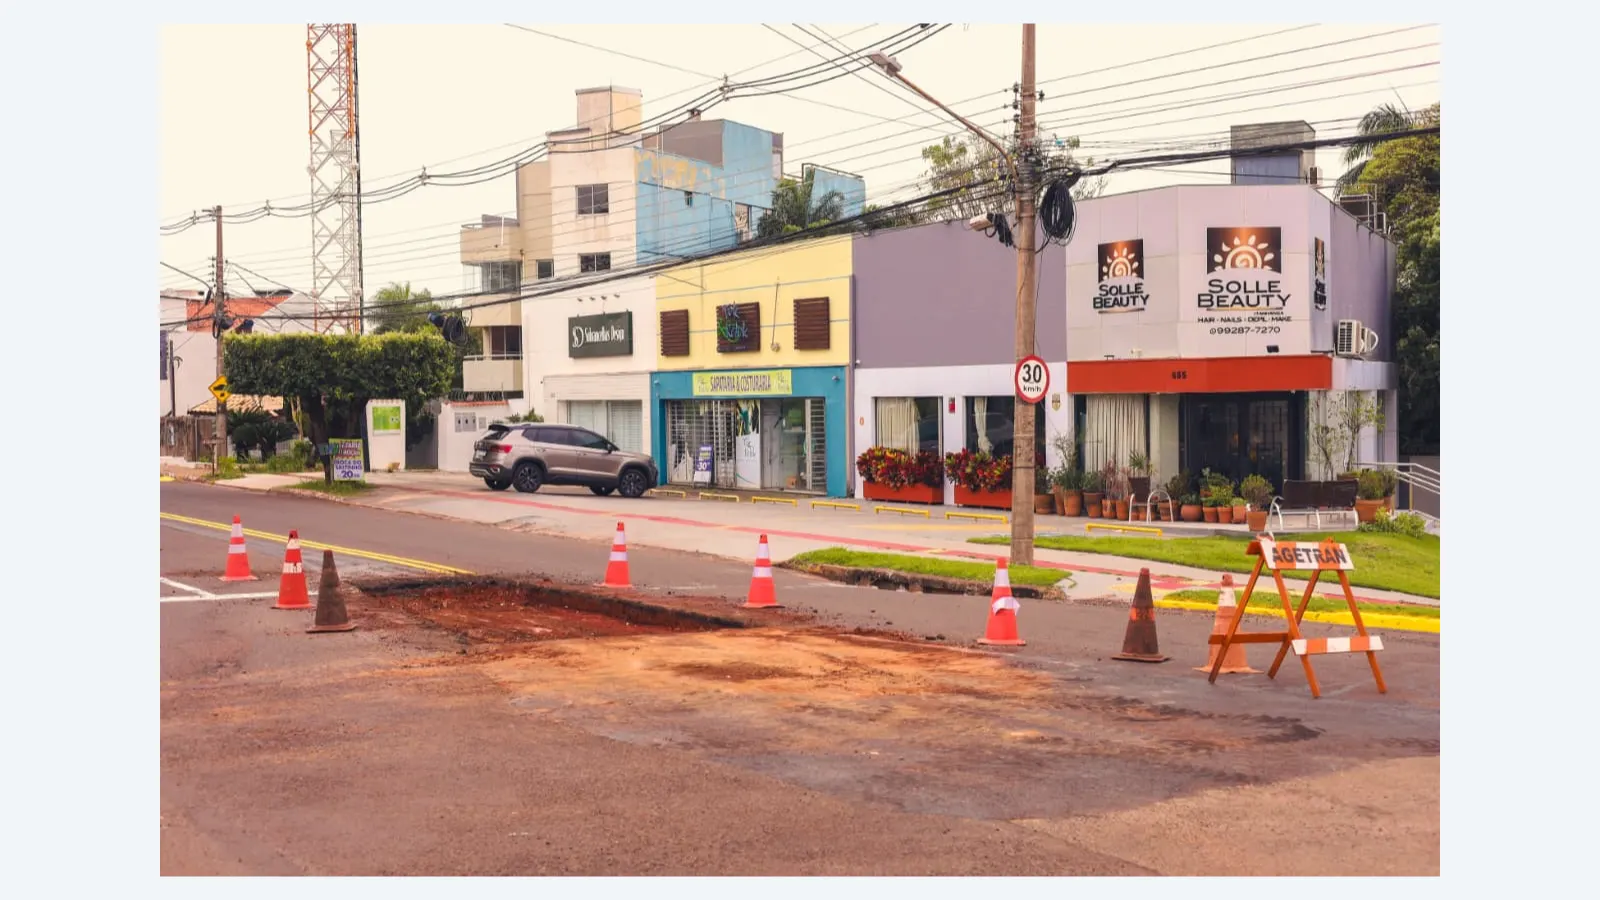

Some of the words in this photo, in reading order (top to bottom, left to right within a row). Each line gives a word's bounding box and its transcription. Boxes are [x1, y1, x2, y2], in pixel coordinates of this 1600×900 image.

[1099, 283, 1143, 296] SOLLE
[1208, 279, 1281, 293] SOLLE
[1093, 294, 1150, 308] BEAUTY
[1198, 293, 1291, 307] BEAUTY
[1217, 326, 1280, 334] 99287-7270
[1022, 363, 1042, 383] 30
[710, 376, 735, 392] SAPATARIA
[1272, 547, 1347, 564] AGETRAN
